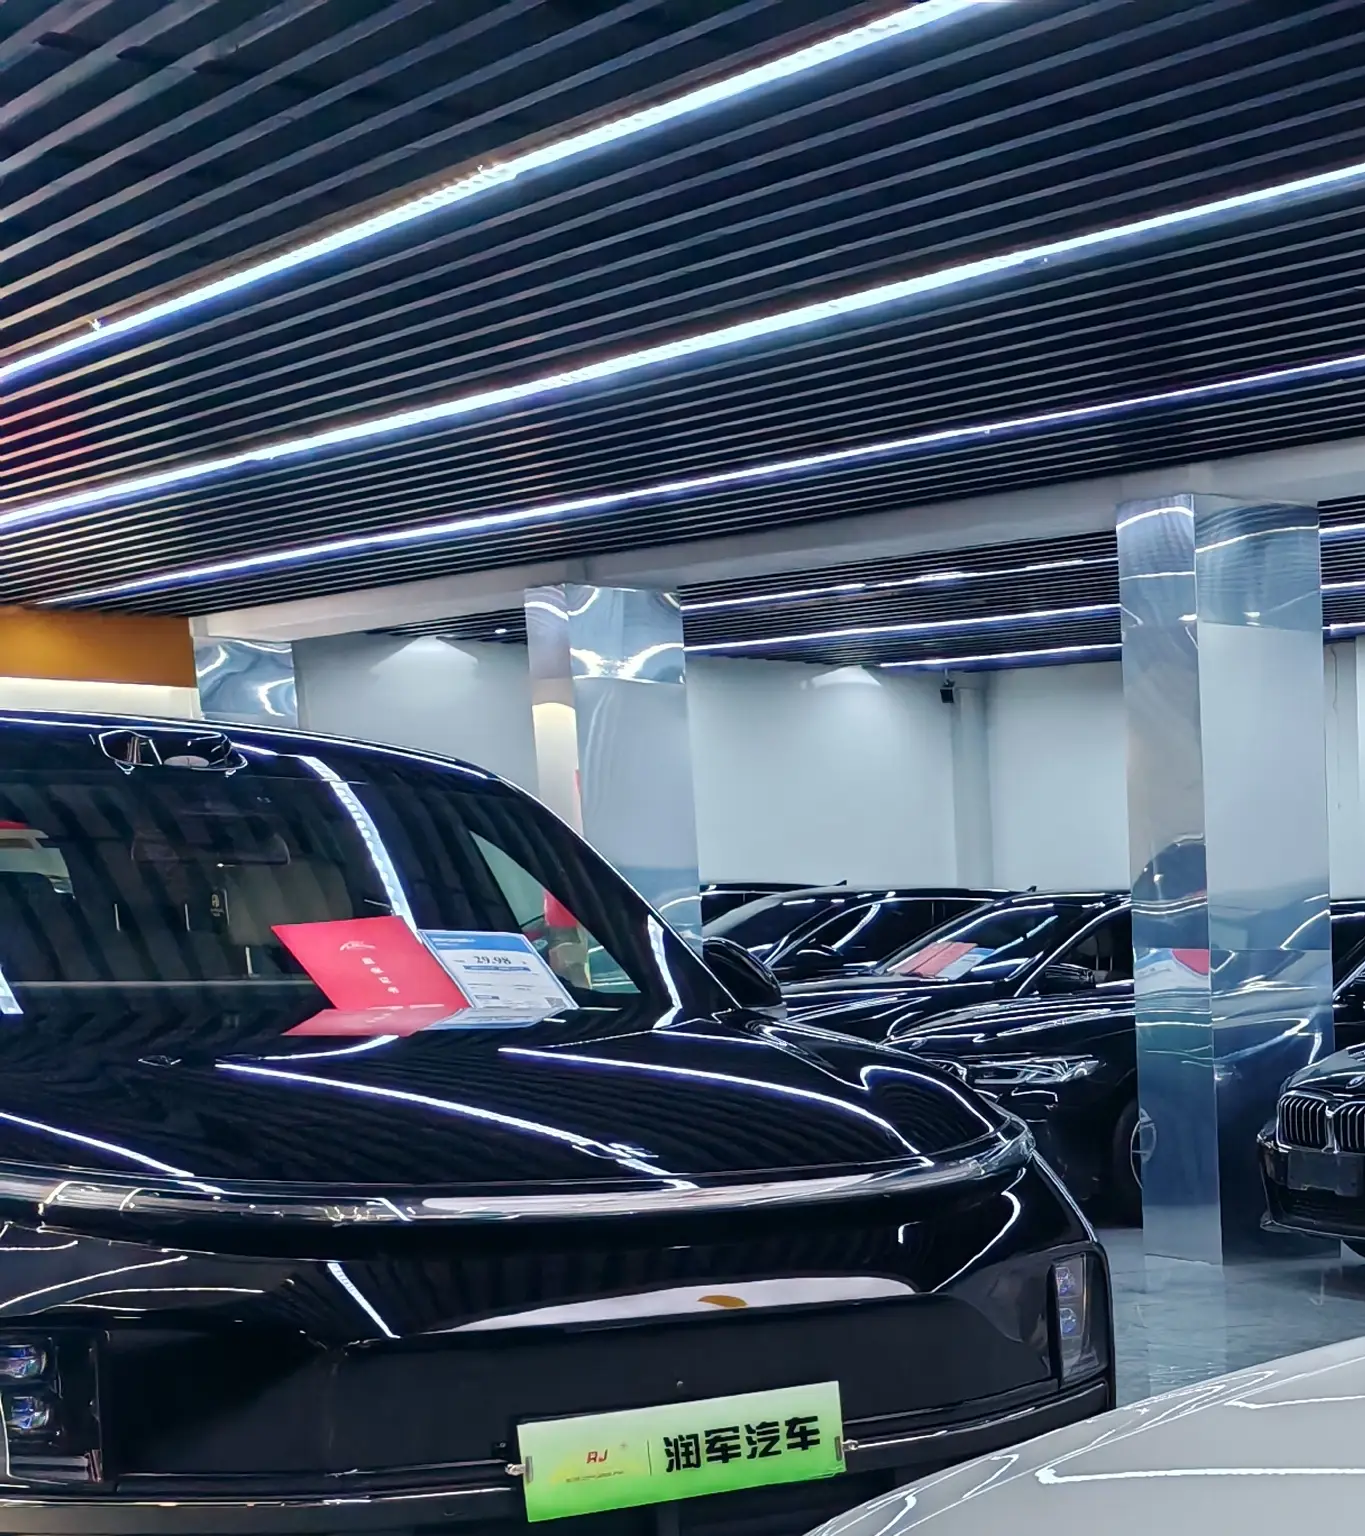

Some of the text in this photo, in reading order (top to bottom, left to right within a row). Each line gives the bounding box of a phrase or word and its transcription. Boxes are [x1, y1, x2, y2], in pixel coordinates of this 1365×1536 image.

[586, 1449, 608, 1464] RJ
[662, 1415, 821, 1473] 润军汽车
